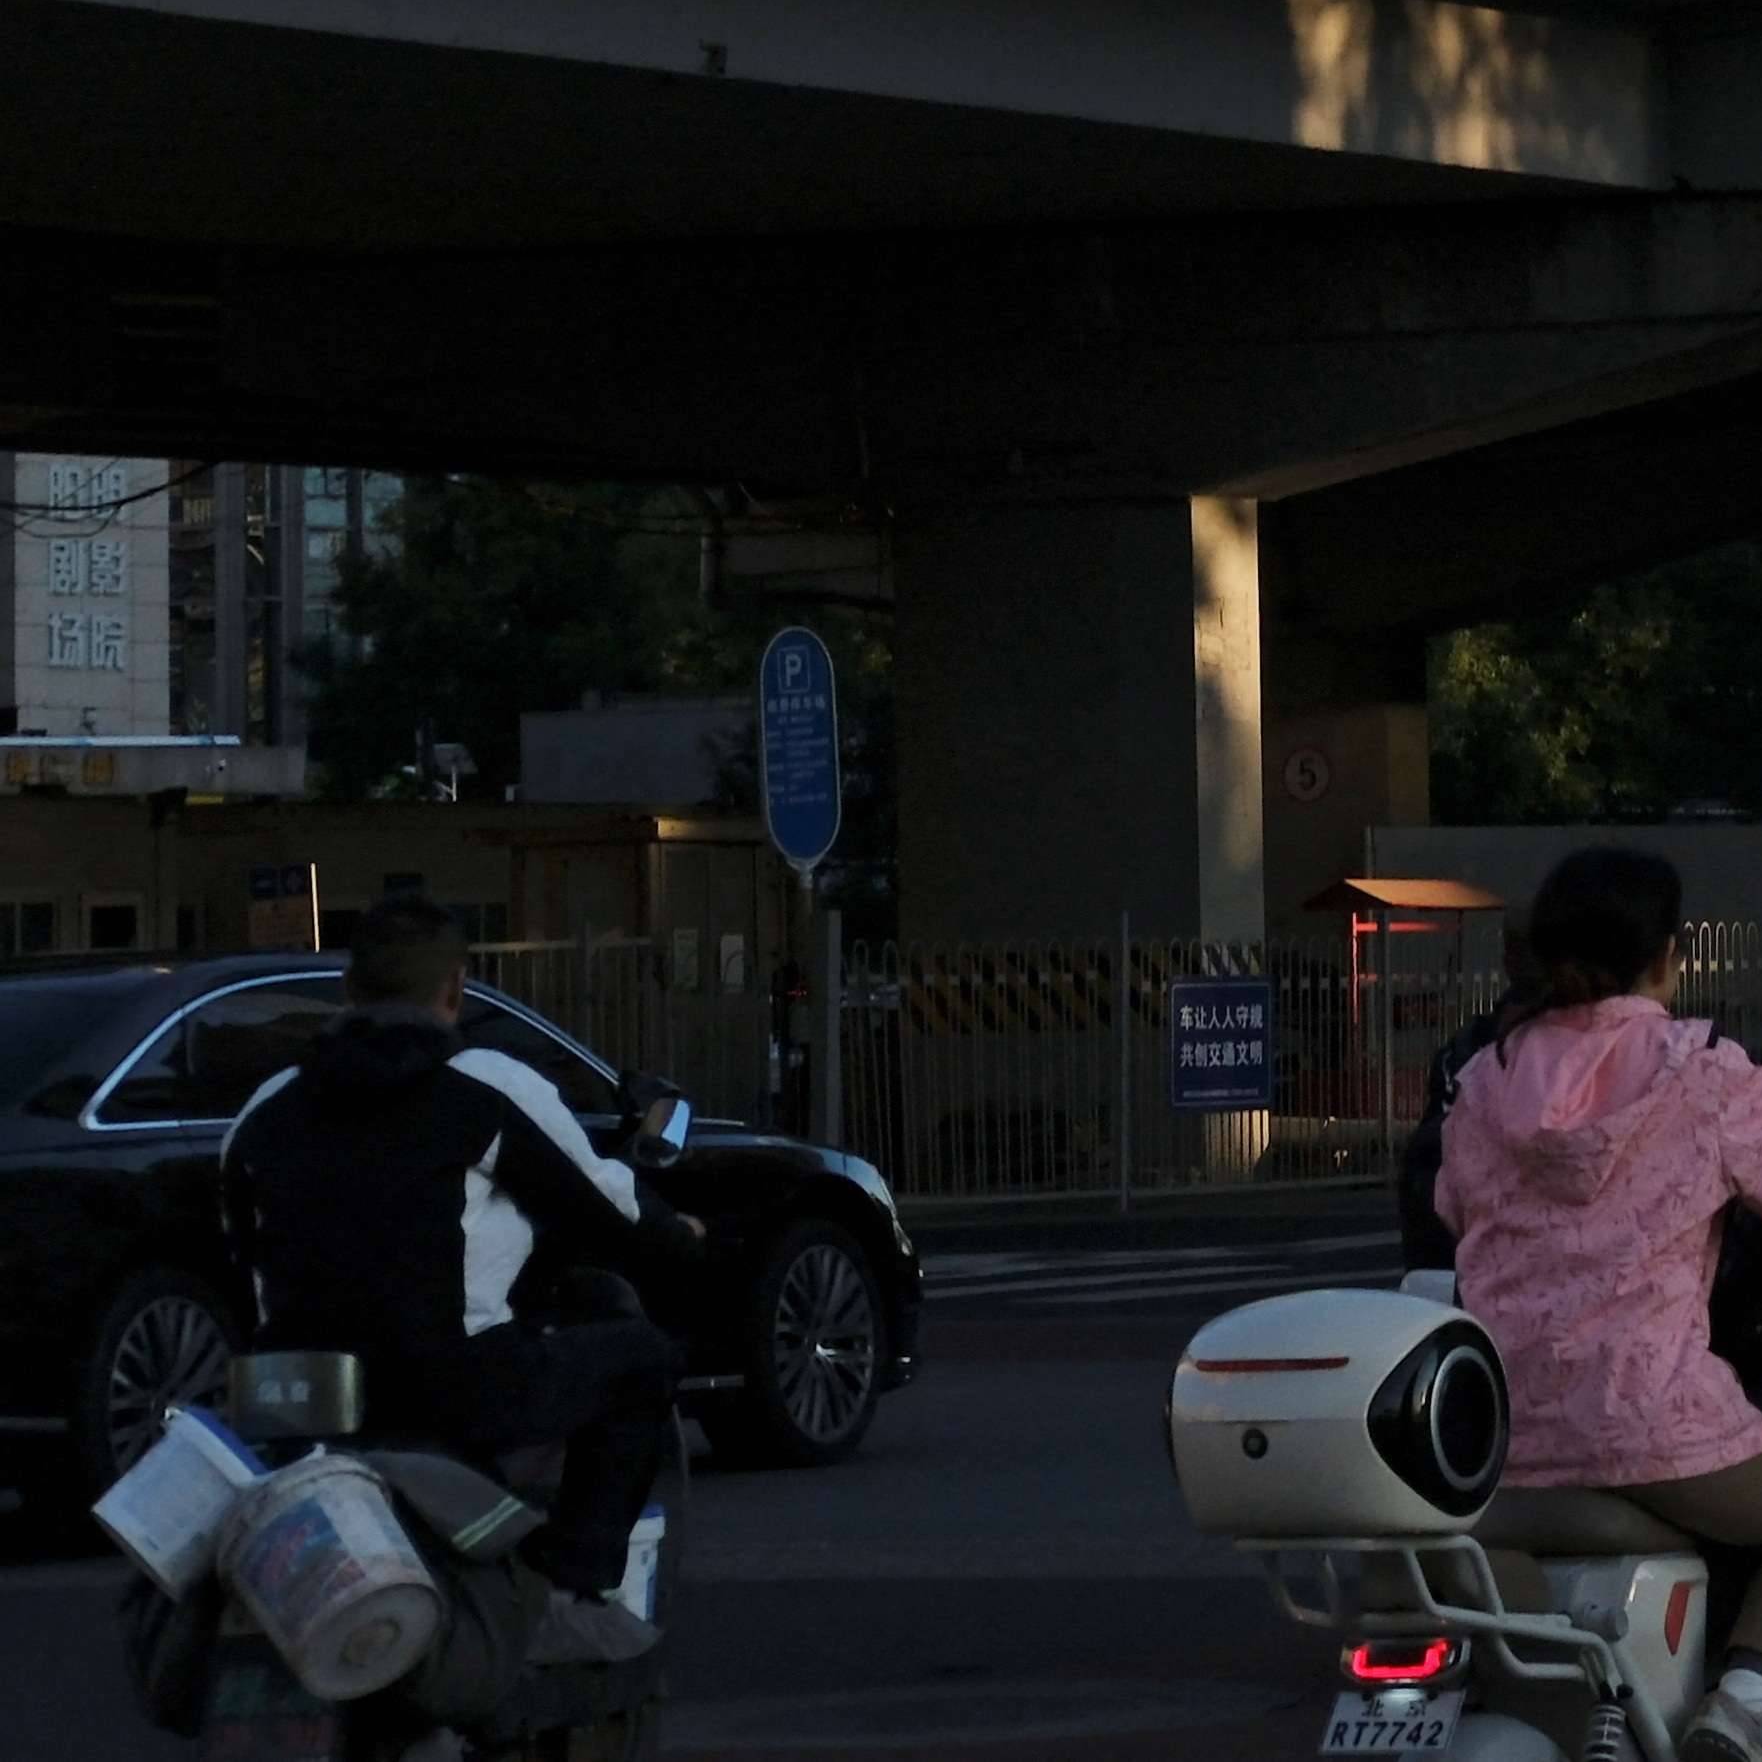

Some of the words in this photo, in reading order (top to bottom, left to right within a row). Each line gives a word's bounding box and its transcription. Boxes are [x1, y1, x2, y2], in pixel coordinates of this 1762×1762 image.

[1180, 1003, 1263, 1030] 车让人人守规
[1180, 1040, 1263, 1067] 共创交通文明
[1330, 1720, 1444, 1747] RT7742
